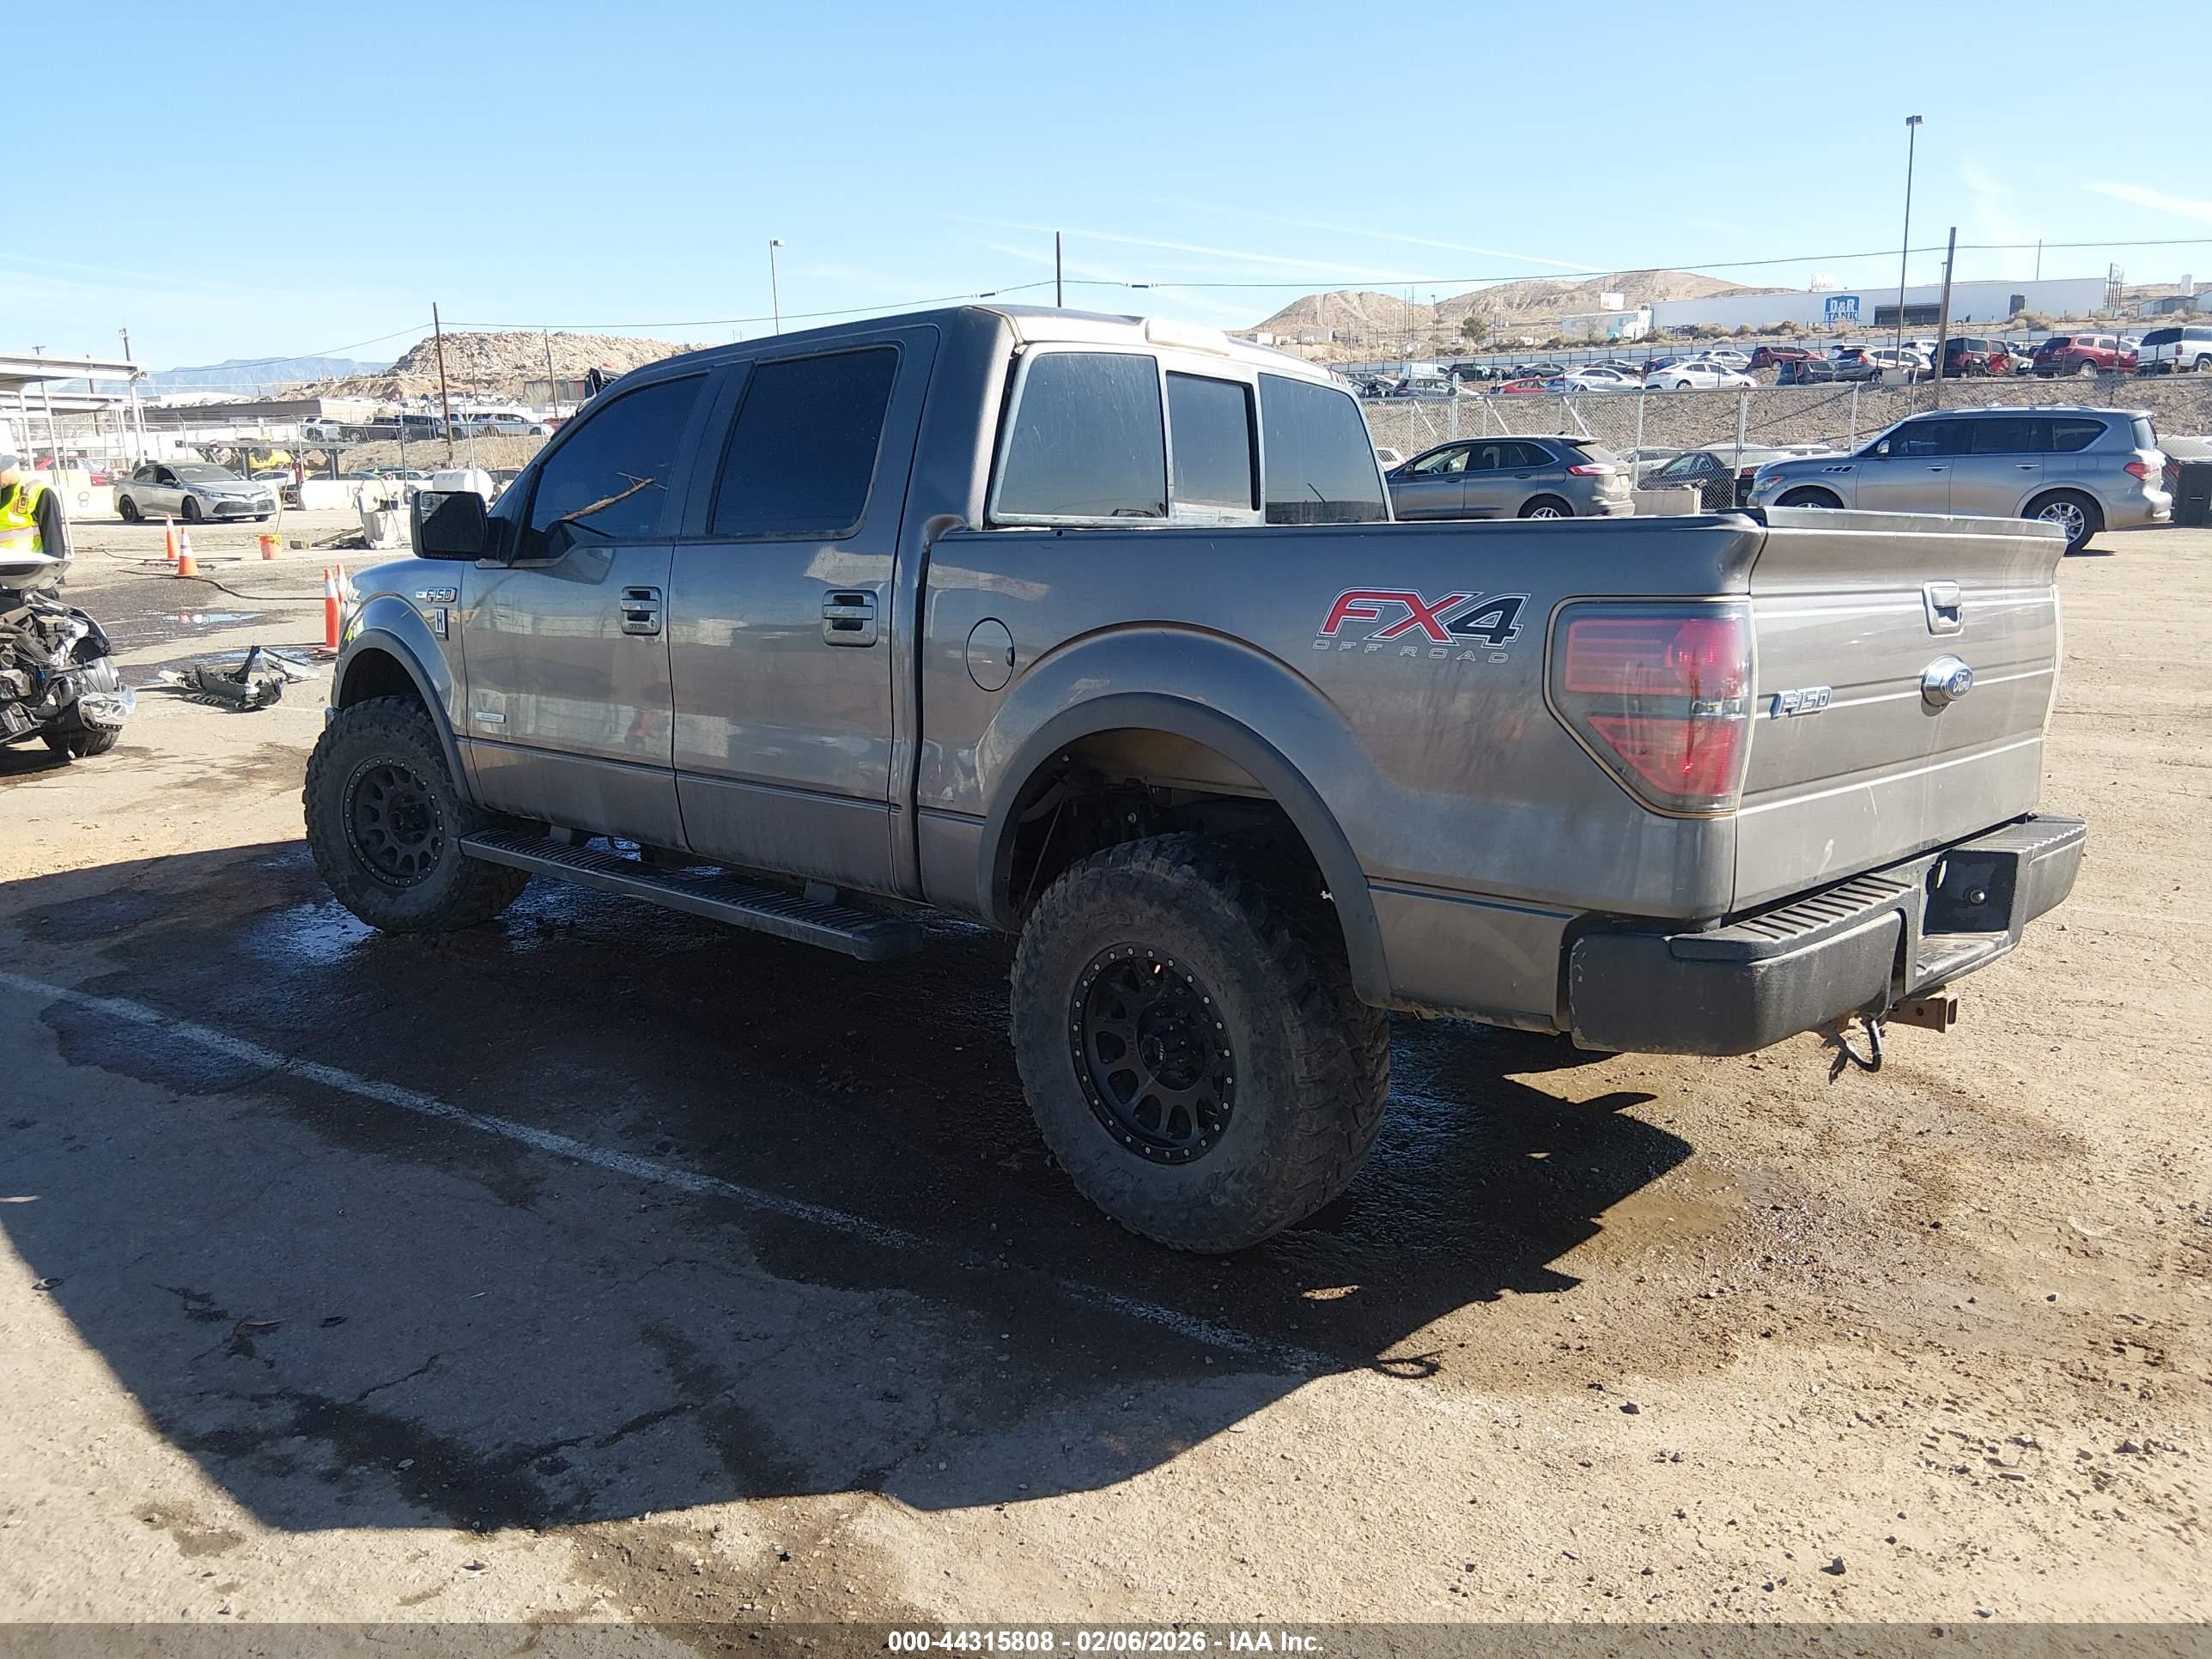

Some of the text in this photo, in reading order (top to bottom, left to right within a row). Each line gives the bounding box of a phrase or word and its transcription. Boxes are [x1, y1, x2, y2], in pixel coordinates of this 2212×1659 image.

[1830, 299, 1856, 313] D&R
[1826, 311, 1857, 321] TANK
[1316, 587, 1531, 649] FX4
[1312, 640, 1509, 664] OFF ROAD
